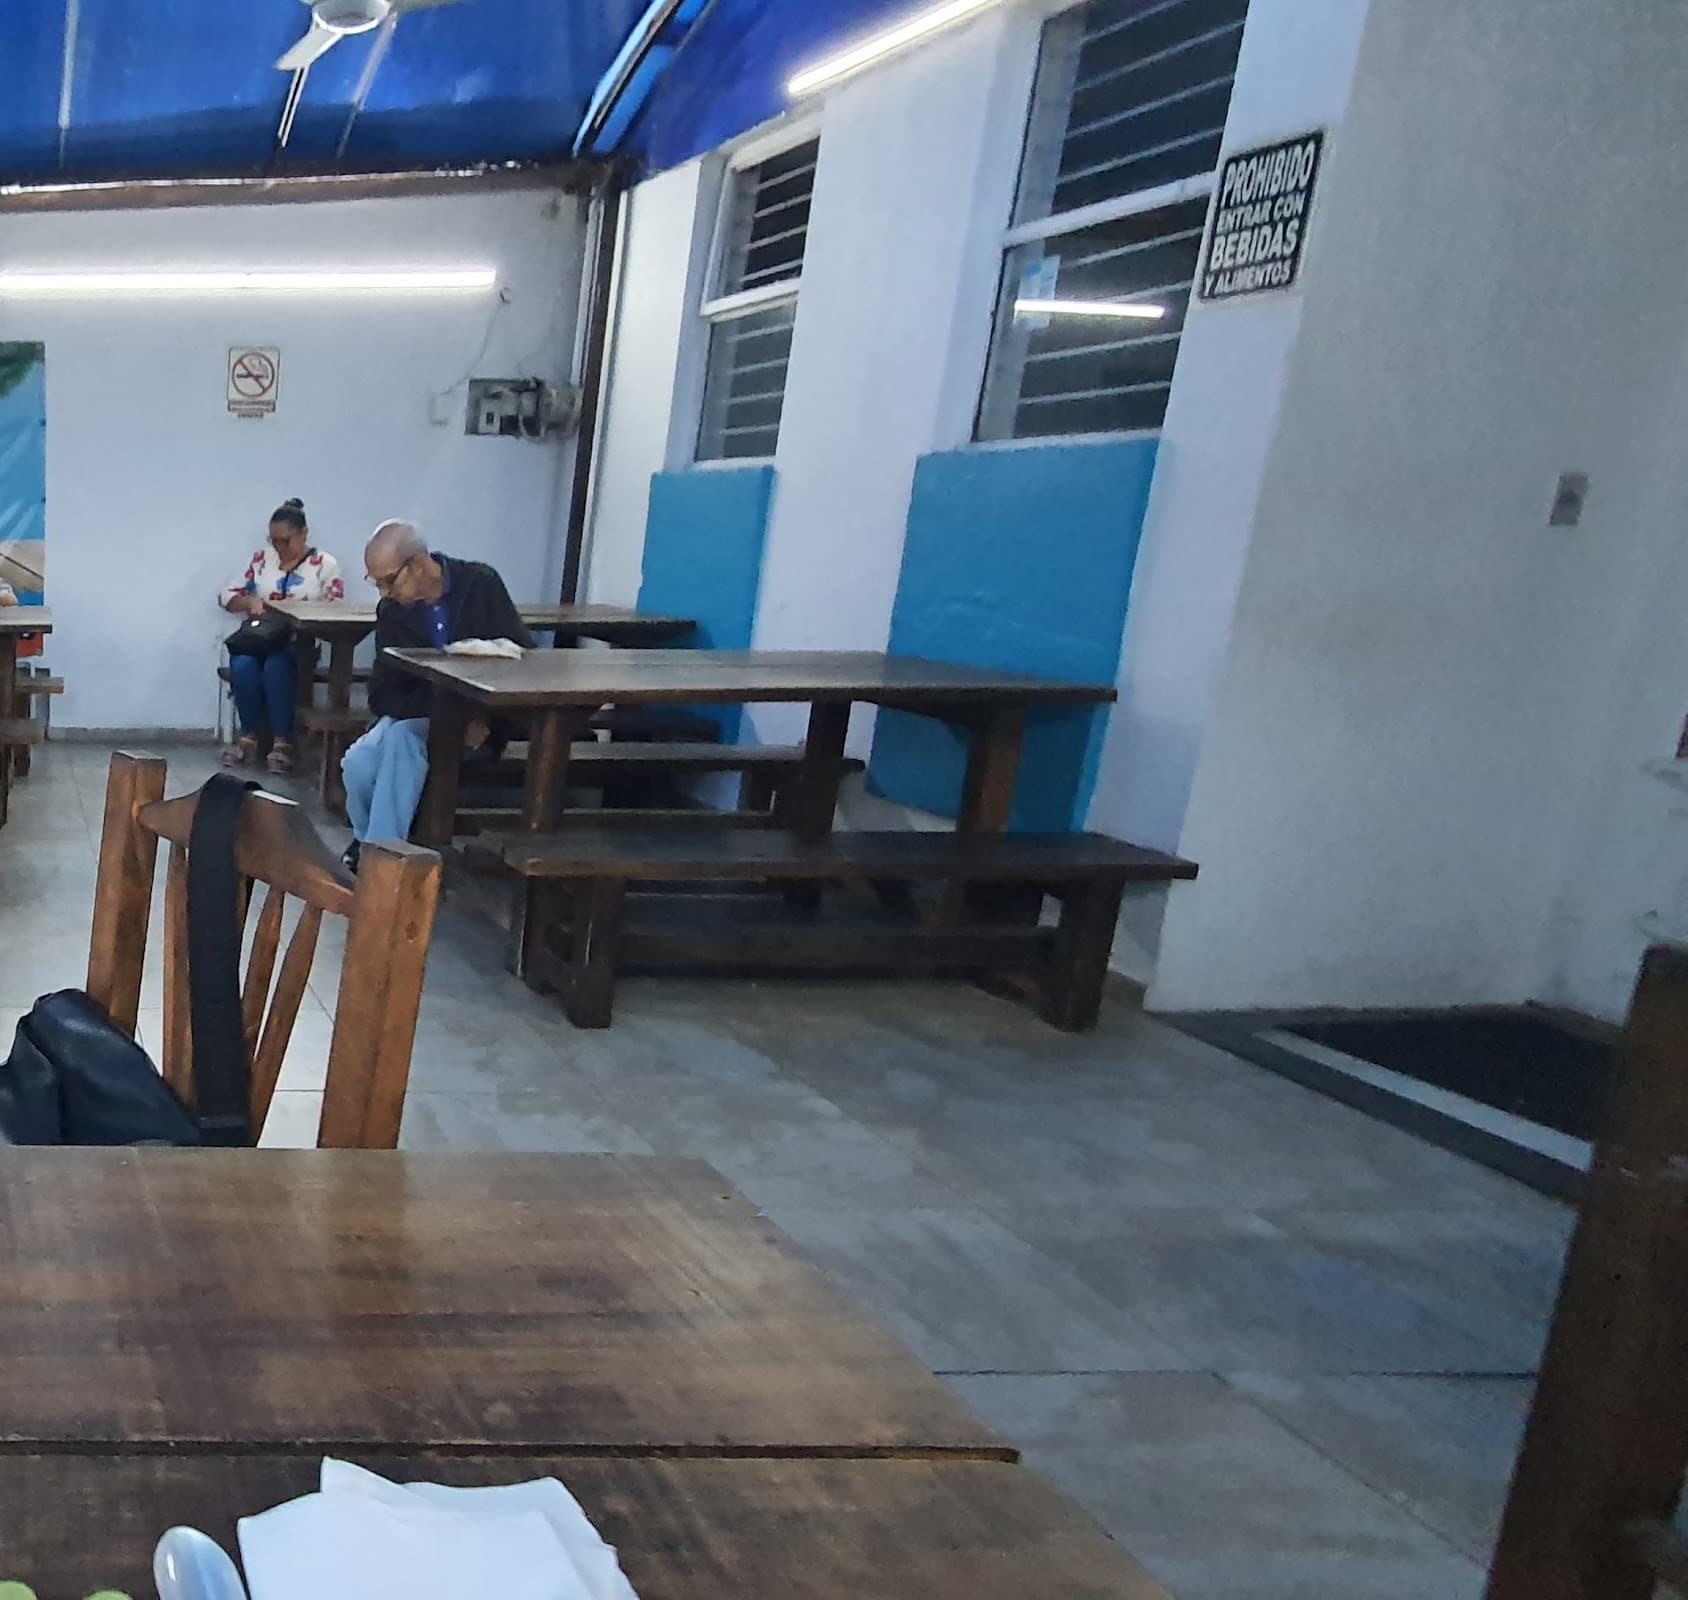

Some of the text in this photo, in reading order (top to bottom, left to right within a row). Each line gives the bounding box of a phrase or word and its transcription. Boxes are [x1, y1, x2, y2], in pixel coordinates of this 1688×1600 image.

[1220, 139, 1316, 208] PROHIBIDO
[1216, 191, 1306, 235] ENTRAR CON
[1209, 218, 1300, 273] BEBIDAS
[1204, 258, 1292, 297] Y ALIMENTOS
